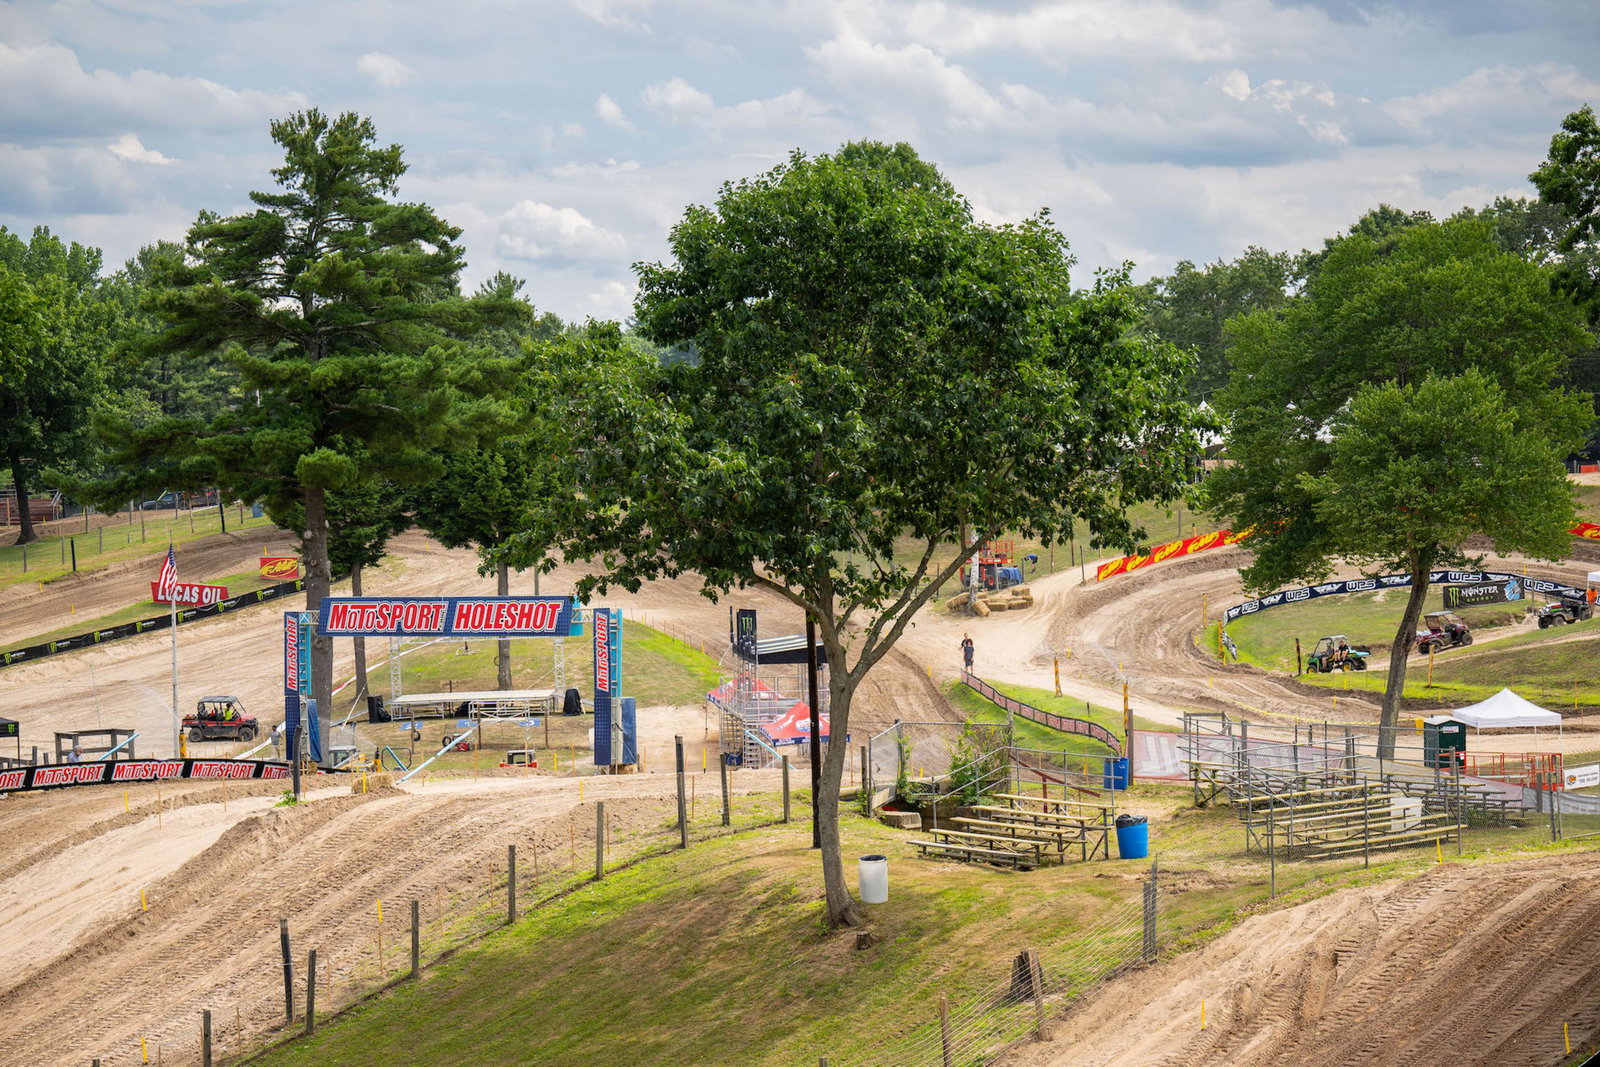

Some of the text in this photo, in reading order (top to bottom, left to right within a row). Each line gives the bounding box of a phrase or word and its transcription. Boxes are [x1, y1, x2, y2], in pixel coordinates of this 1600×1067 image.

[1346, 580, 1376, 591] WPS
[1461, 586, 1499, 597] MONSTER
[202, 587, 221, 603] OIL
[1285, 588, 1310, 602] WPS
[455, 603, 561, 629] HOLESHOT
